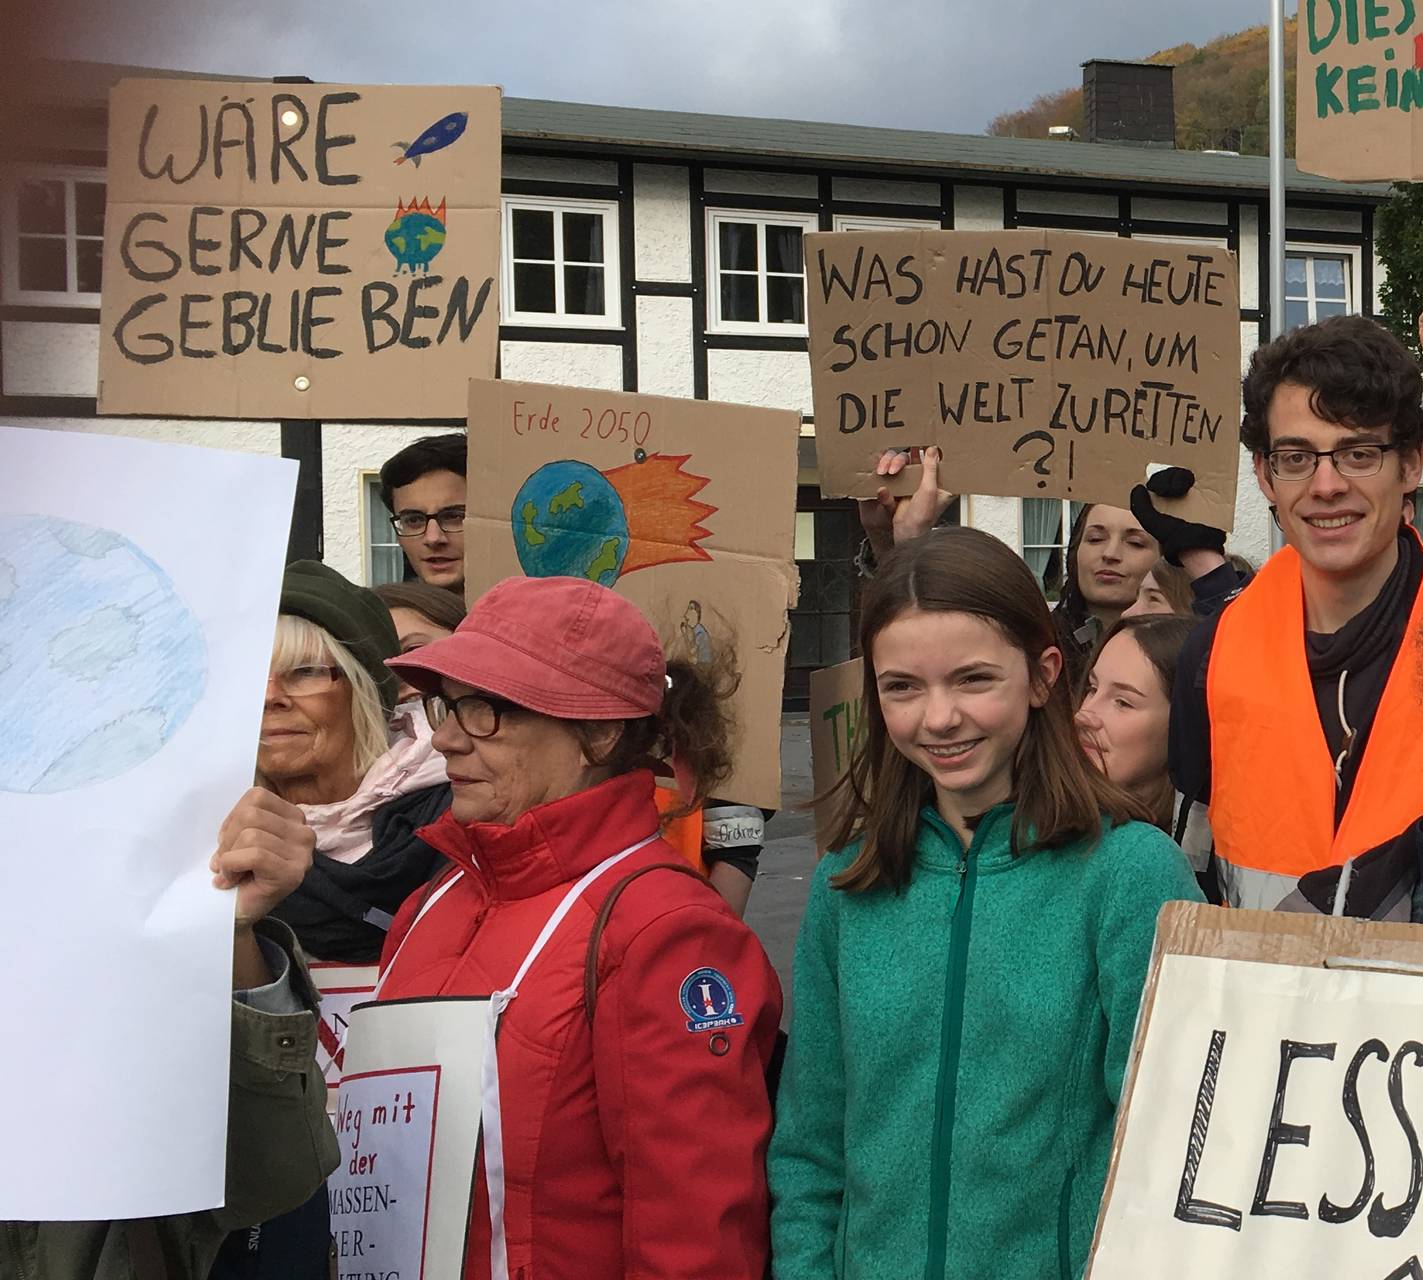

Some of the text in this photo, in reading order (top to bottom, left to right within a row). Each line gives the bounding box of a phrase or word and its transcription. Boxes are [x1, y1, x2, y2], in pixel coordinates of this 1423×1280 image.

[137, 92, 361, 186] WÄRE
[120, 208, 352, 281] GERNE
[818, 246, 1226, 307] WAS HAST DU HEUTE
[831, 315, 1198, 373] SCHON GETAN, UM
[513, 402, 652, 445] Erde 2050
[838, 388, 905, 435] DIE
[938, 377, 1034, 426] WELT
[372, 1092, 416, 1125] mit
[350, 1151, 378, 1175] der
